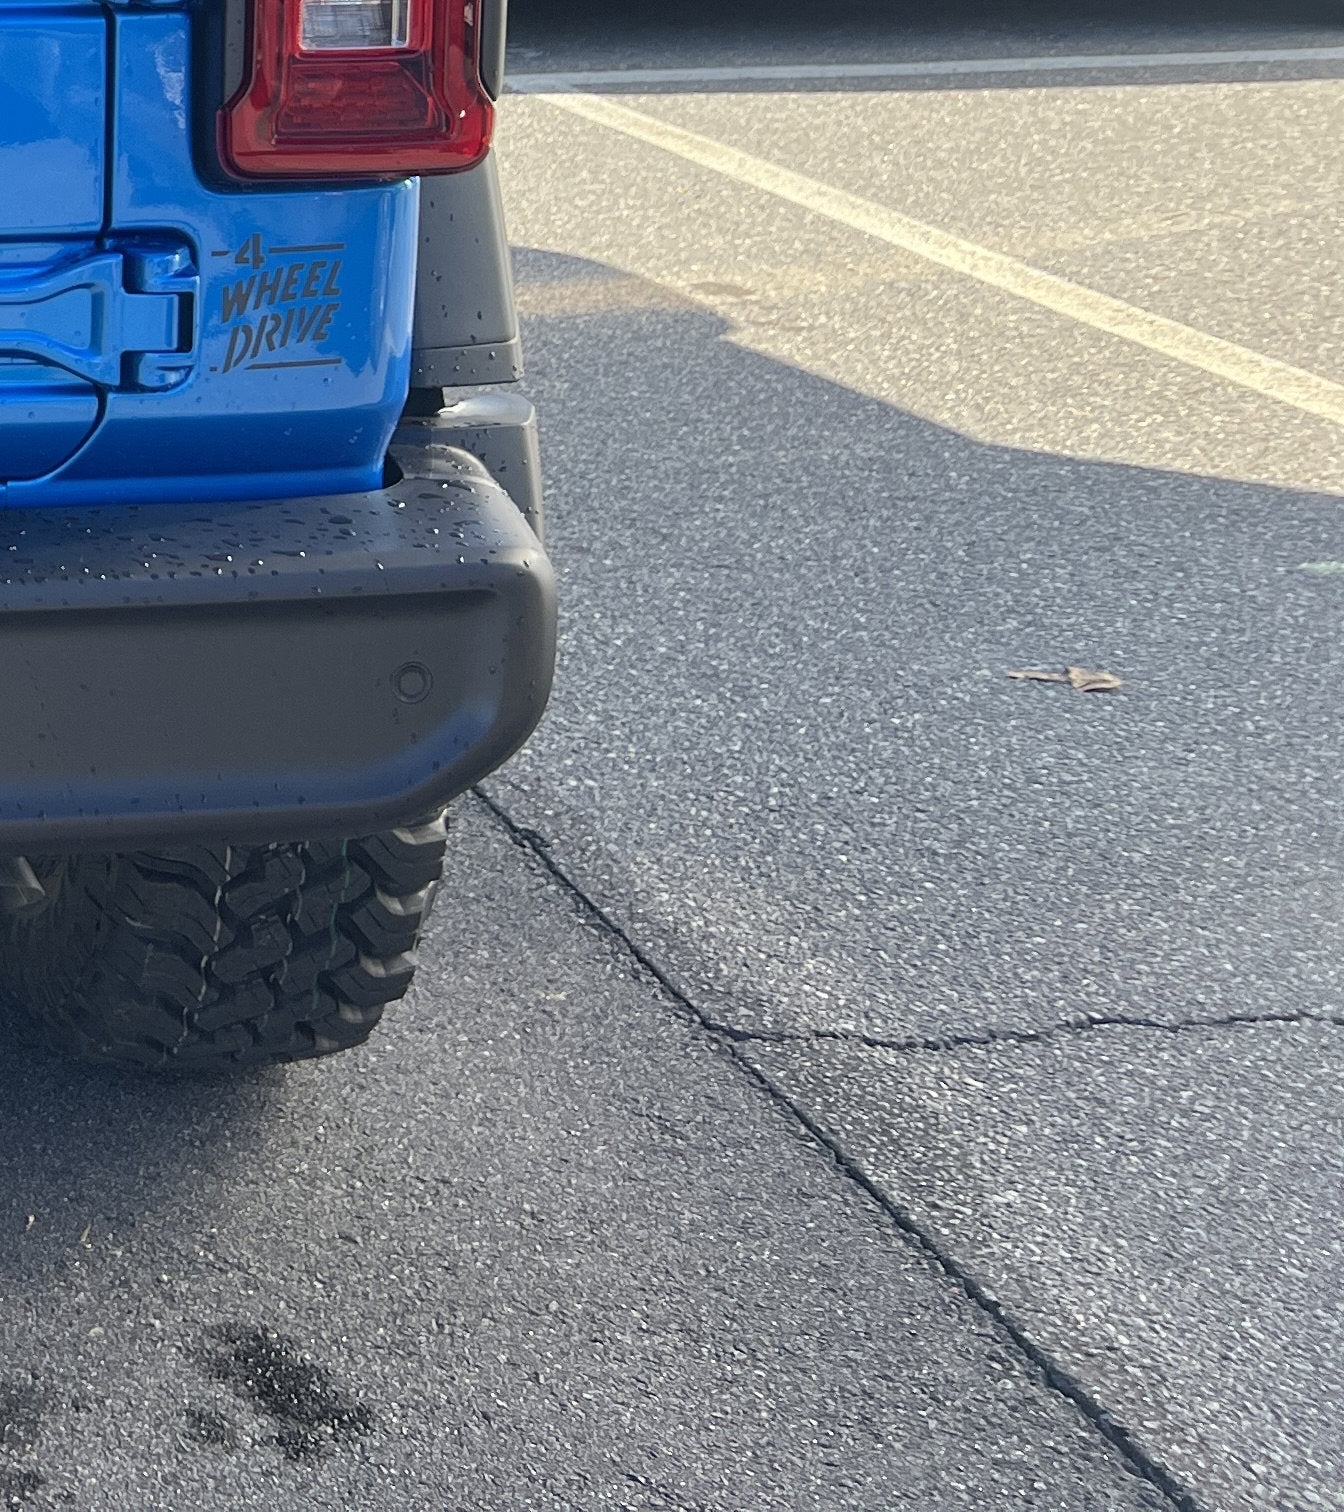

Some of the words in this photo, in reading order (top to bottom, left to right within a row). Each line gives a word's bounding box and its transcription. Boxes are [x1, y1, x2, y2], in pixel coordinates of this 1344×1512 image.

[234, 232, 265, 269] 4
[221, 259, 341, 323] WHEEL
[222, 303, 340, 374] DRIVE
